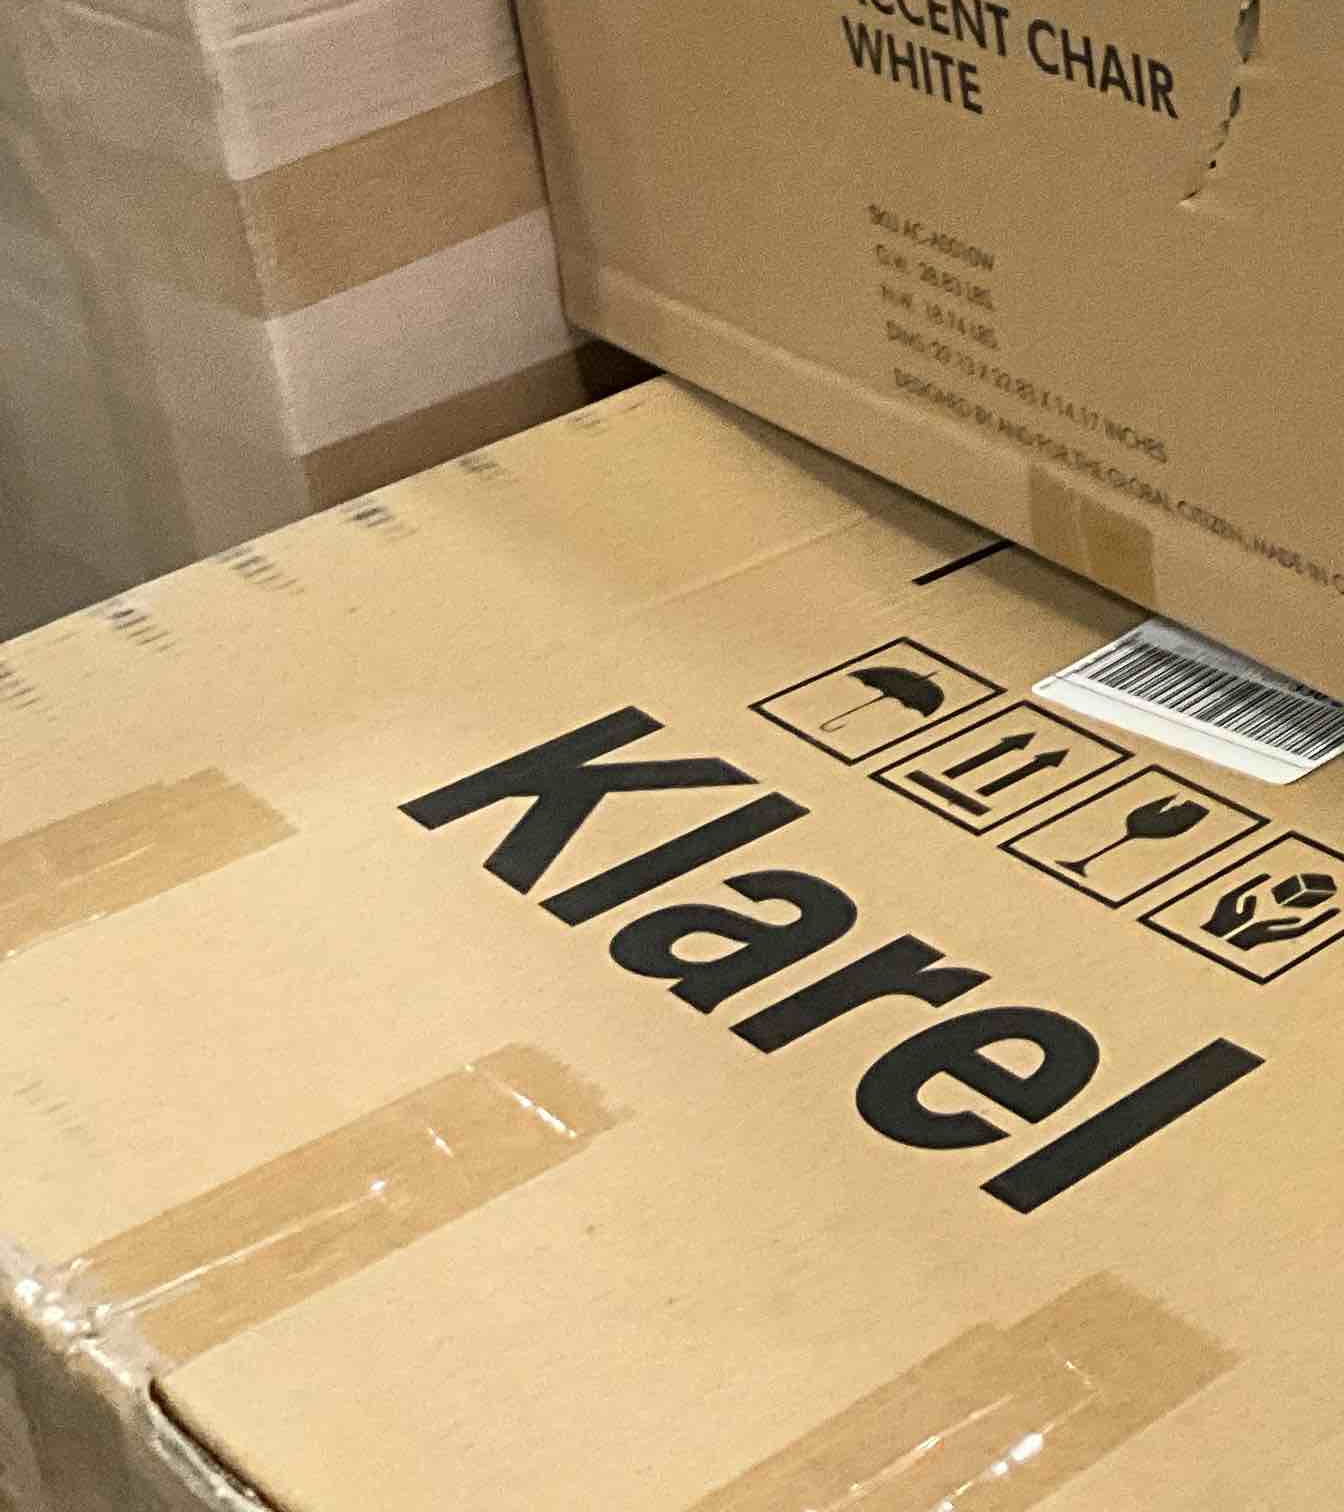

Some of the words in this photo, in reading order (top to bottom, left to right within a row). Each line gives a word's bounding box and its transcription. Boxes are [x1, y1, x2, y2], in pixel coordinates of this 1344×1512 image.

[840, 14, 984, 115] WHITE
[1026, 18, 1180, 120] CHAIR
[396, 704, 1267, 1216] Klarel
